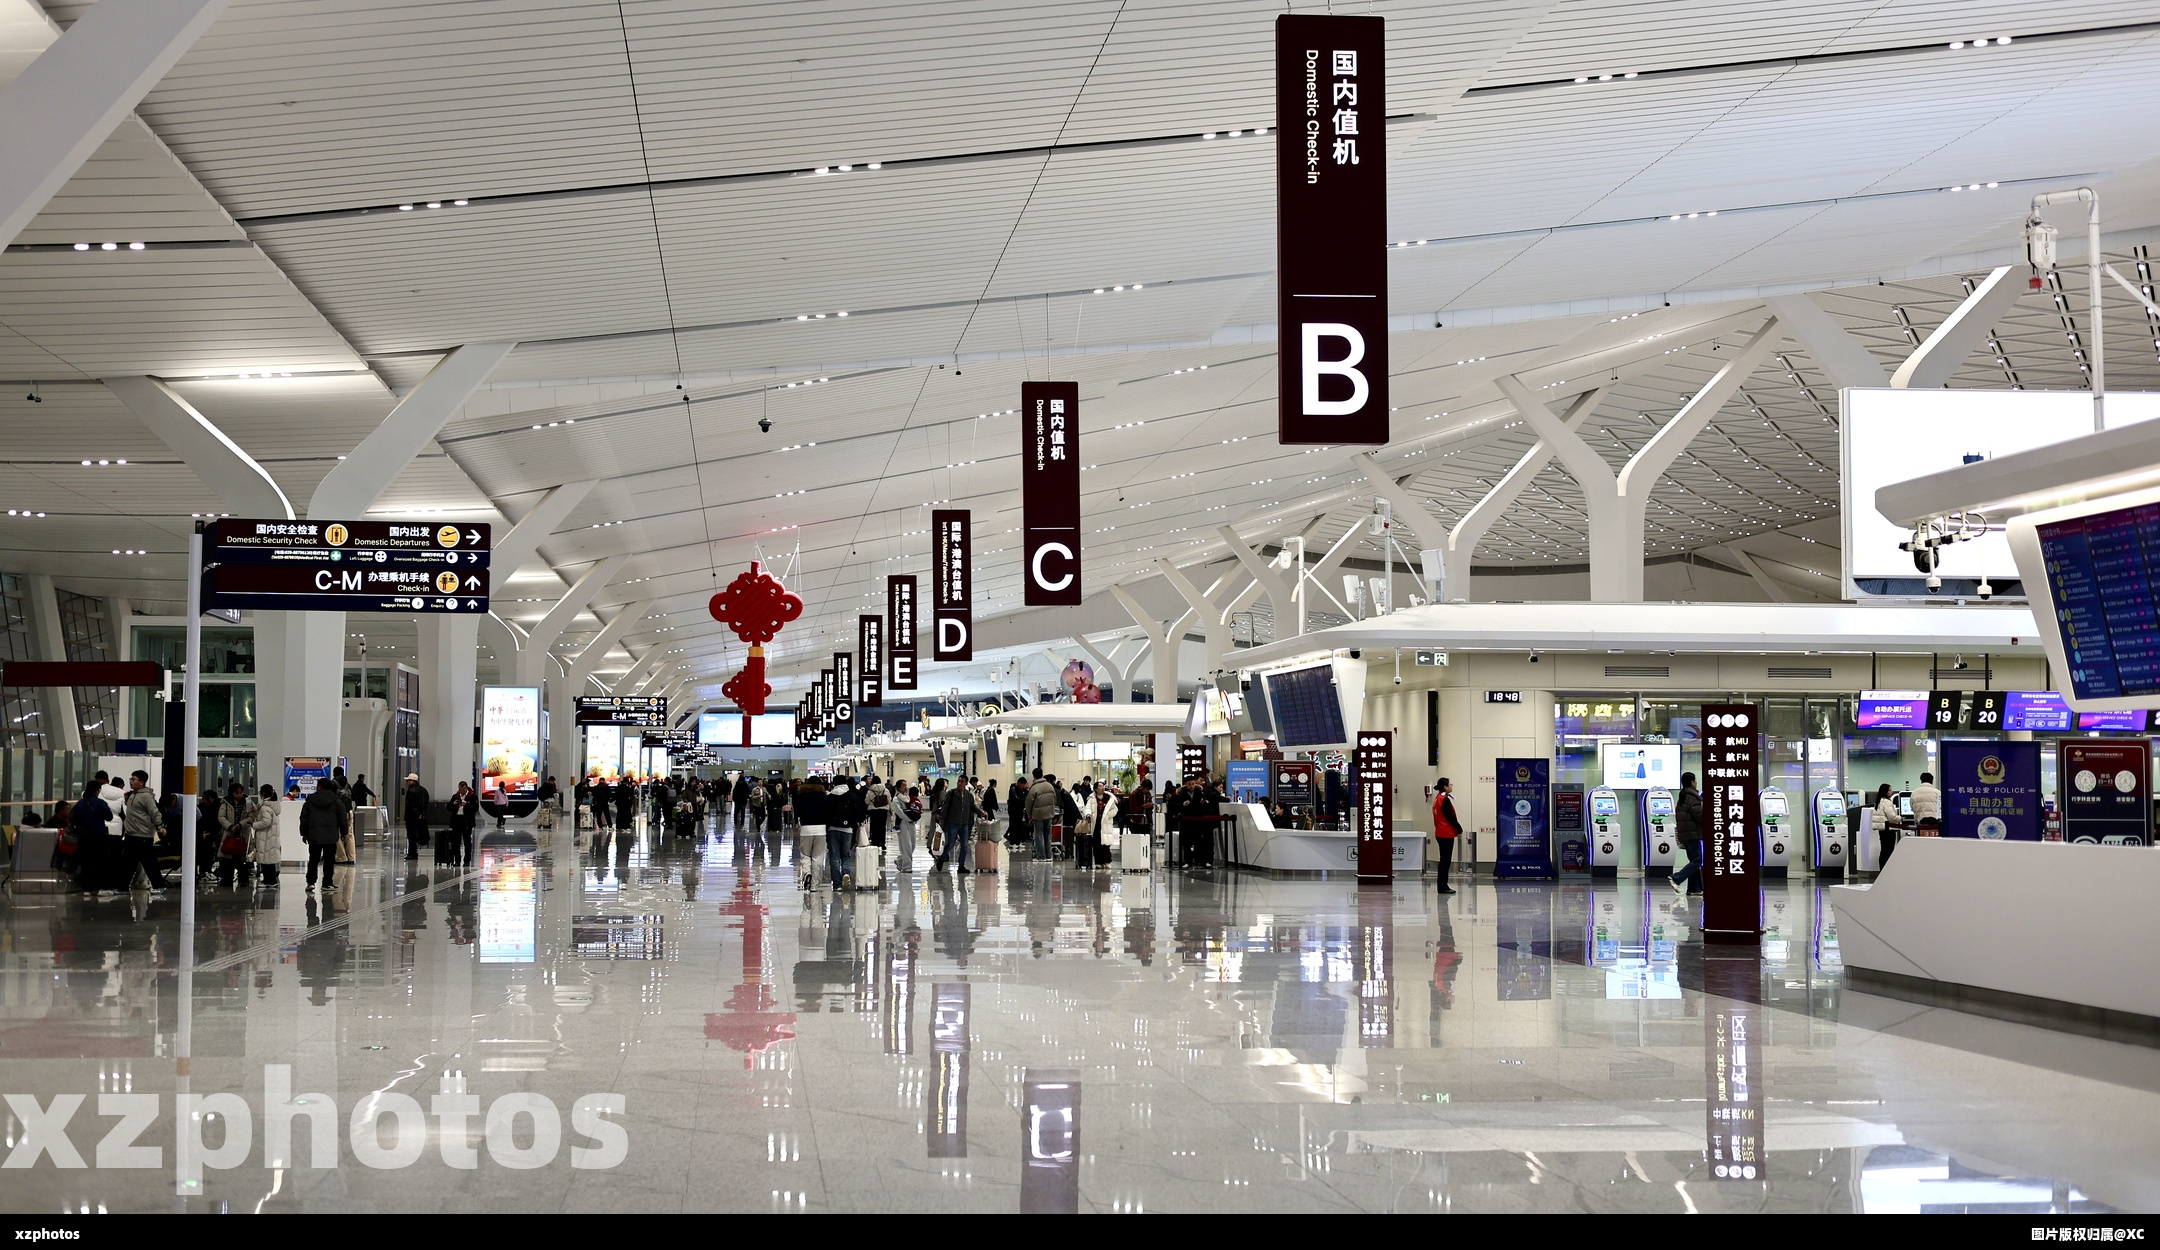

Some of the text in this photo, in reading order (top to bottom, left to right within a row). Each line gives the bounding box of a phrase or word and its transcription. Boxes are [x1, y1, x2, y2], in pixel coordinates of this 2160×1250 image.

[1332, 50, 1360, 165] 国内值机
[1306, 50, 1321, 184] Domestic Check-in
[1302, 323, 1369, 416] B
[1036, 399, 1045, 471] Domestic Check-in
[1050, 399, 1066, 460] 国内值机
[256, 524, 318, 536] 国内安全检查
[389, 526, 430, 537] 国内出发
[227, 536, 318, 547] Domestic Security Check
[354, 538, 430, 549] Domestic Departures
[1032, 542, 1074, 592] C
[315, 570, 362, 591] C-M
[368, 572, 430, 583] 办理乘机手续
[397, 584, 430, 593] Check-in
[939, 618, 967, 652] D
[894, 657, 911, 683] E
[863, 680, 877, 702] F
[1941, 698, 1949, 708] B
[1985, 699, 1993, 709] B
[836, 703, 851, 720] G
[1935, 711, 1951, 723] 19
[1978, 711, 1997, 723] 20
[814, 720, 822, 733] J
[823, 713, 835, 728] H
[1707, 737, 1717, 746] 东
[1707, 753, 1717, 762] 上
[1970, 797, 2014, 807] 自助办理
[1373, 783, 1383, 840] 国内值机区
[1713, 785, 1724, 876] Domestic Check-in
[1728, 785, 1745, 874] 国内值机区
